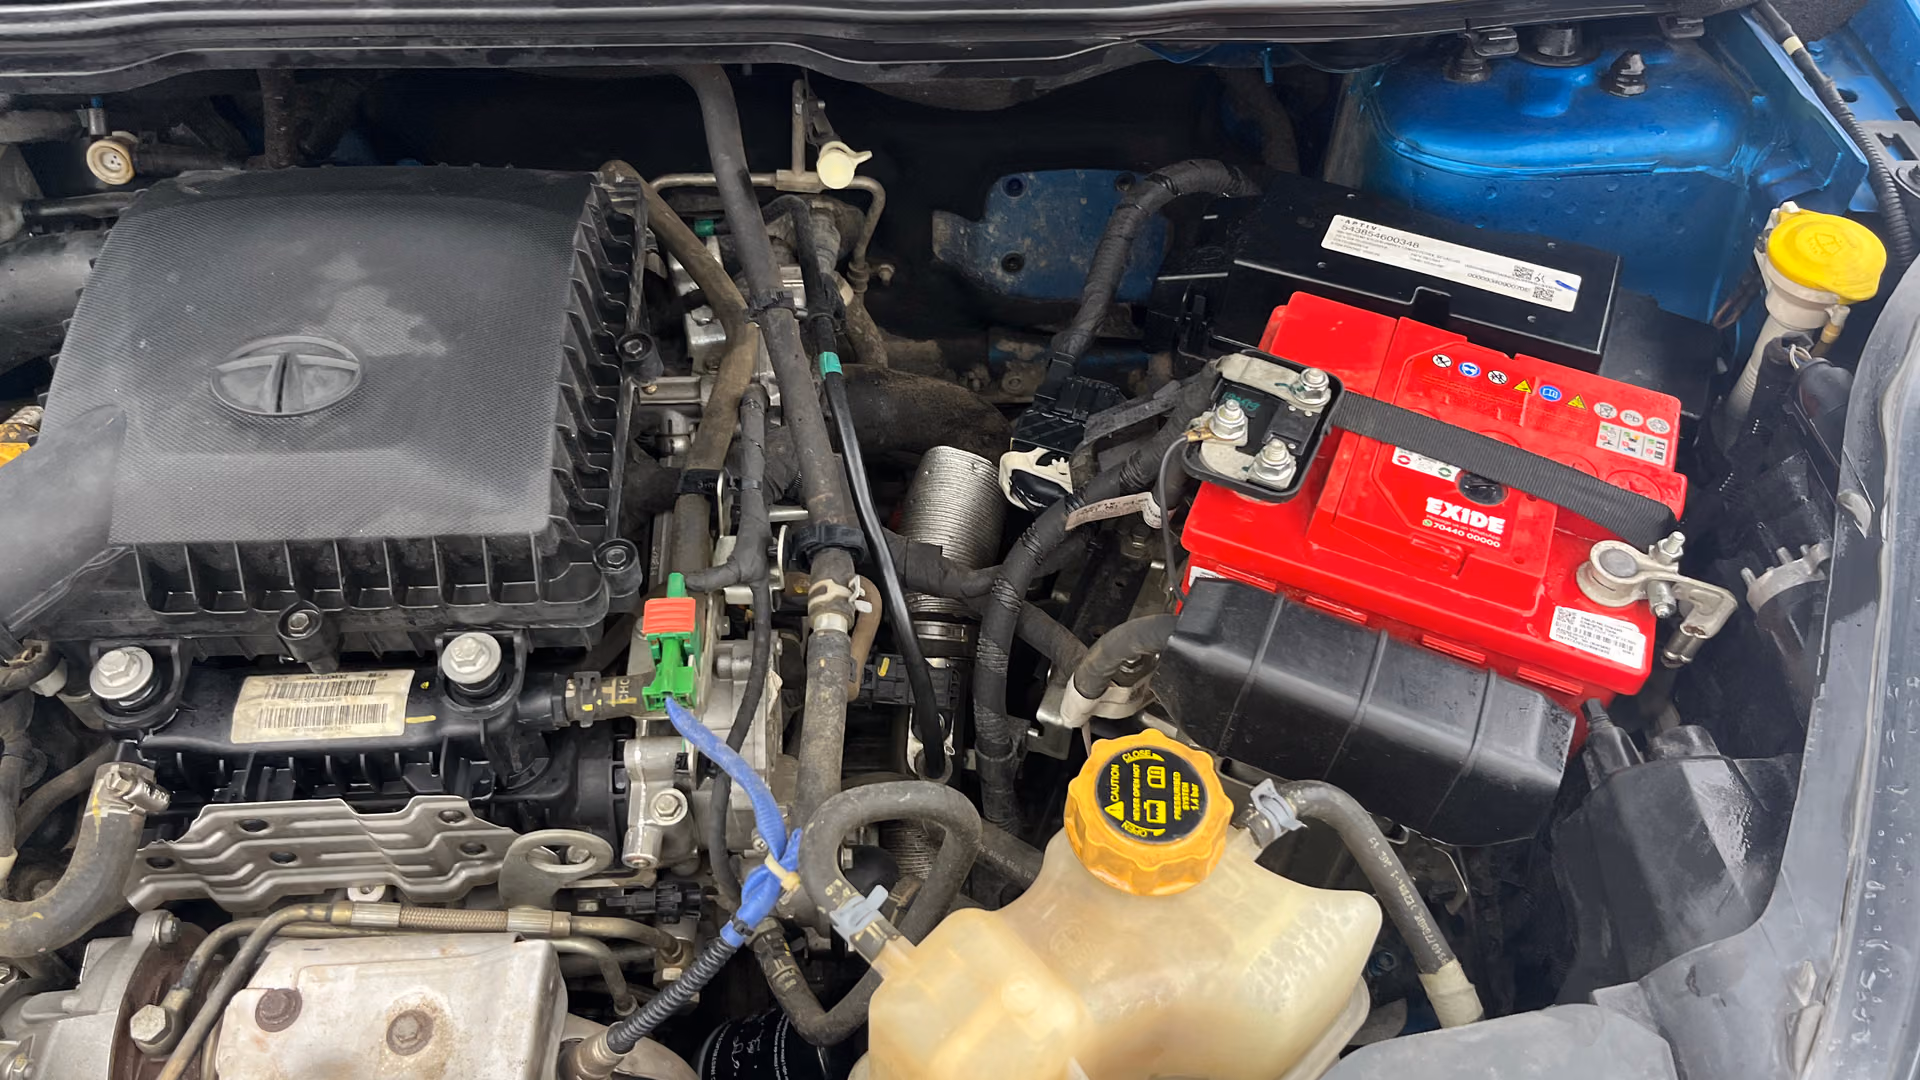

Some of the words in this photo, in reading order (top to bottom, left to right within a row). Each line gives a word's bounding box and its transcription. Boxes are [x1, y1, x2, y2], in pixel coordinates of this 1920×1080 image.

[1344, 219, 1378, 231] APTIV
[1341, 224, 1420, 248] 543854600348
[1624, 412, 1640, 423] Pb
[1425, 497, 1506, 535] EXIDE
[1433, 521, 1465, 537] 70440
[1466, 532, 1501, 548] 00000
[1122, 749, 1152, 762] CLOSE
[1110, 764, 1120, 802] CAUTION
[1190, 783, 1200, 798] bar
[1182, 782, 1190, 810] SYSTEM
[1121, 820, 1148, 838] OPEN
